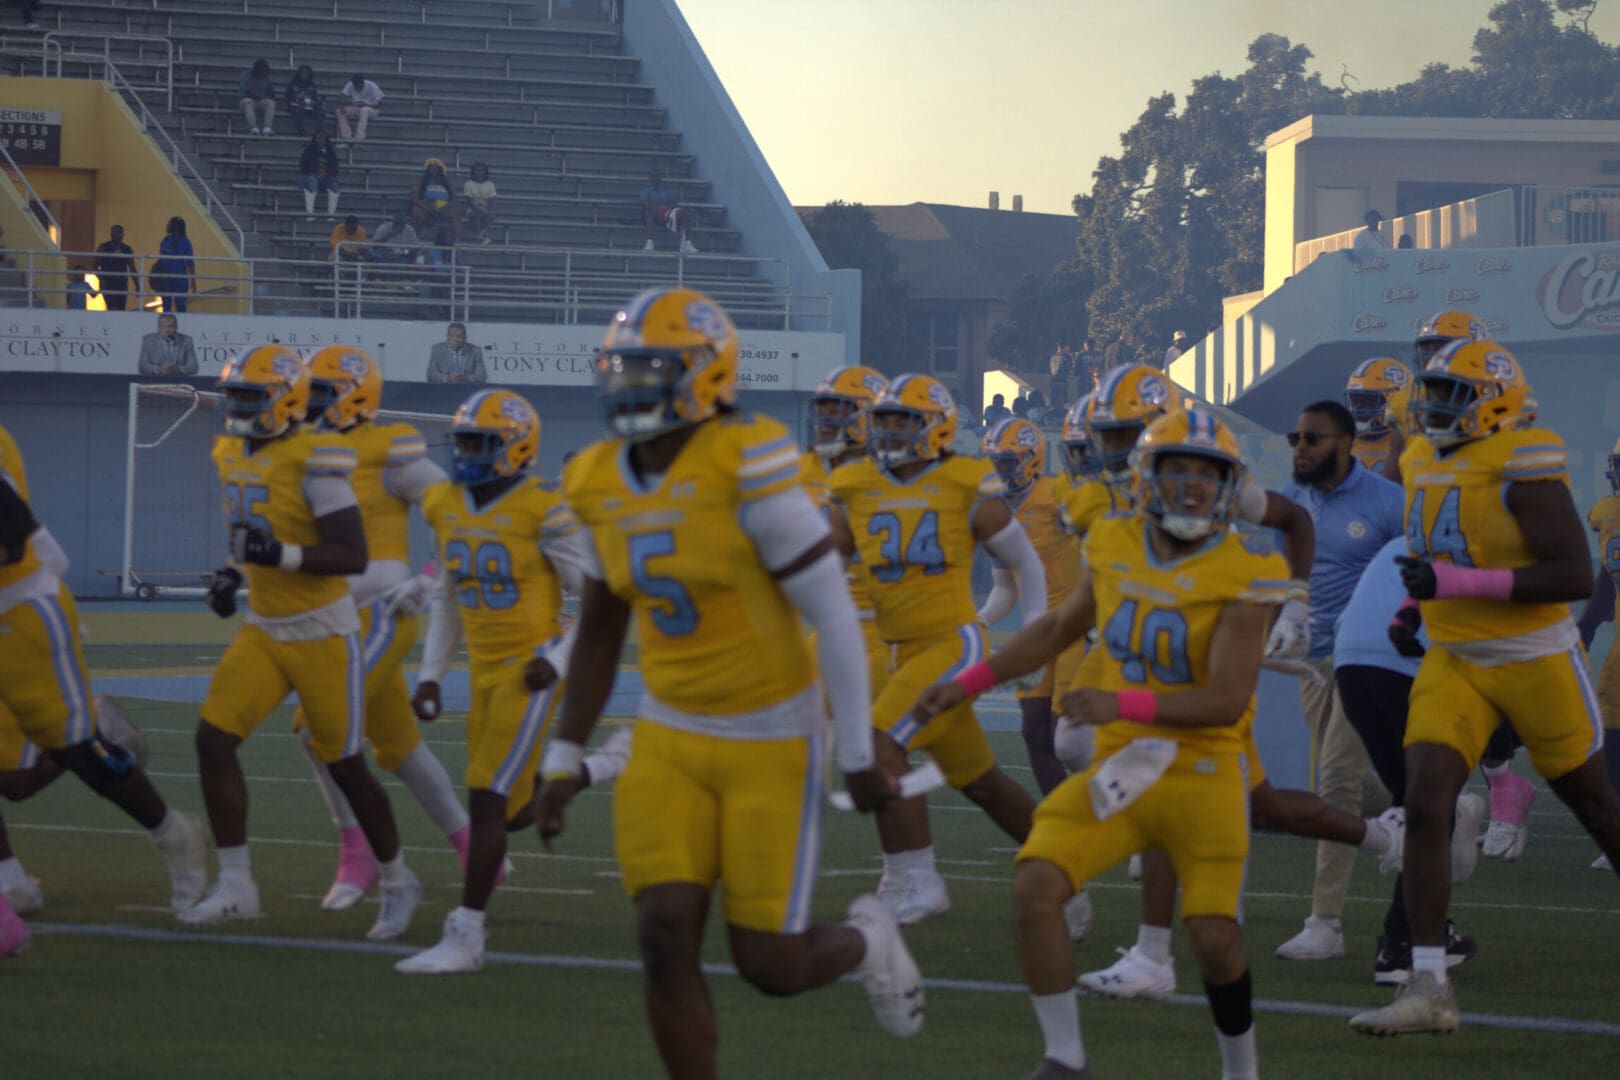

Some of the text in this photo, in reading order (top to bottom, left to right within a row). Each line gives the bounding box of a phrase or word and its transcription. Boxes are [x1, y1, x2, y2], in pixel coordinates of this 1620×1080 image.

[8, 340, 111, 357] CLAYTON
[489, 356, 548, 371] TONY
[737, 350, 779, 359] 30.4937
[446, 540, 521, 609] 28
[867, 510, 947, 583] 34
[627, 530, 701, 637] 5
[1103, 598, 1194, 685] 40
